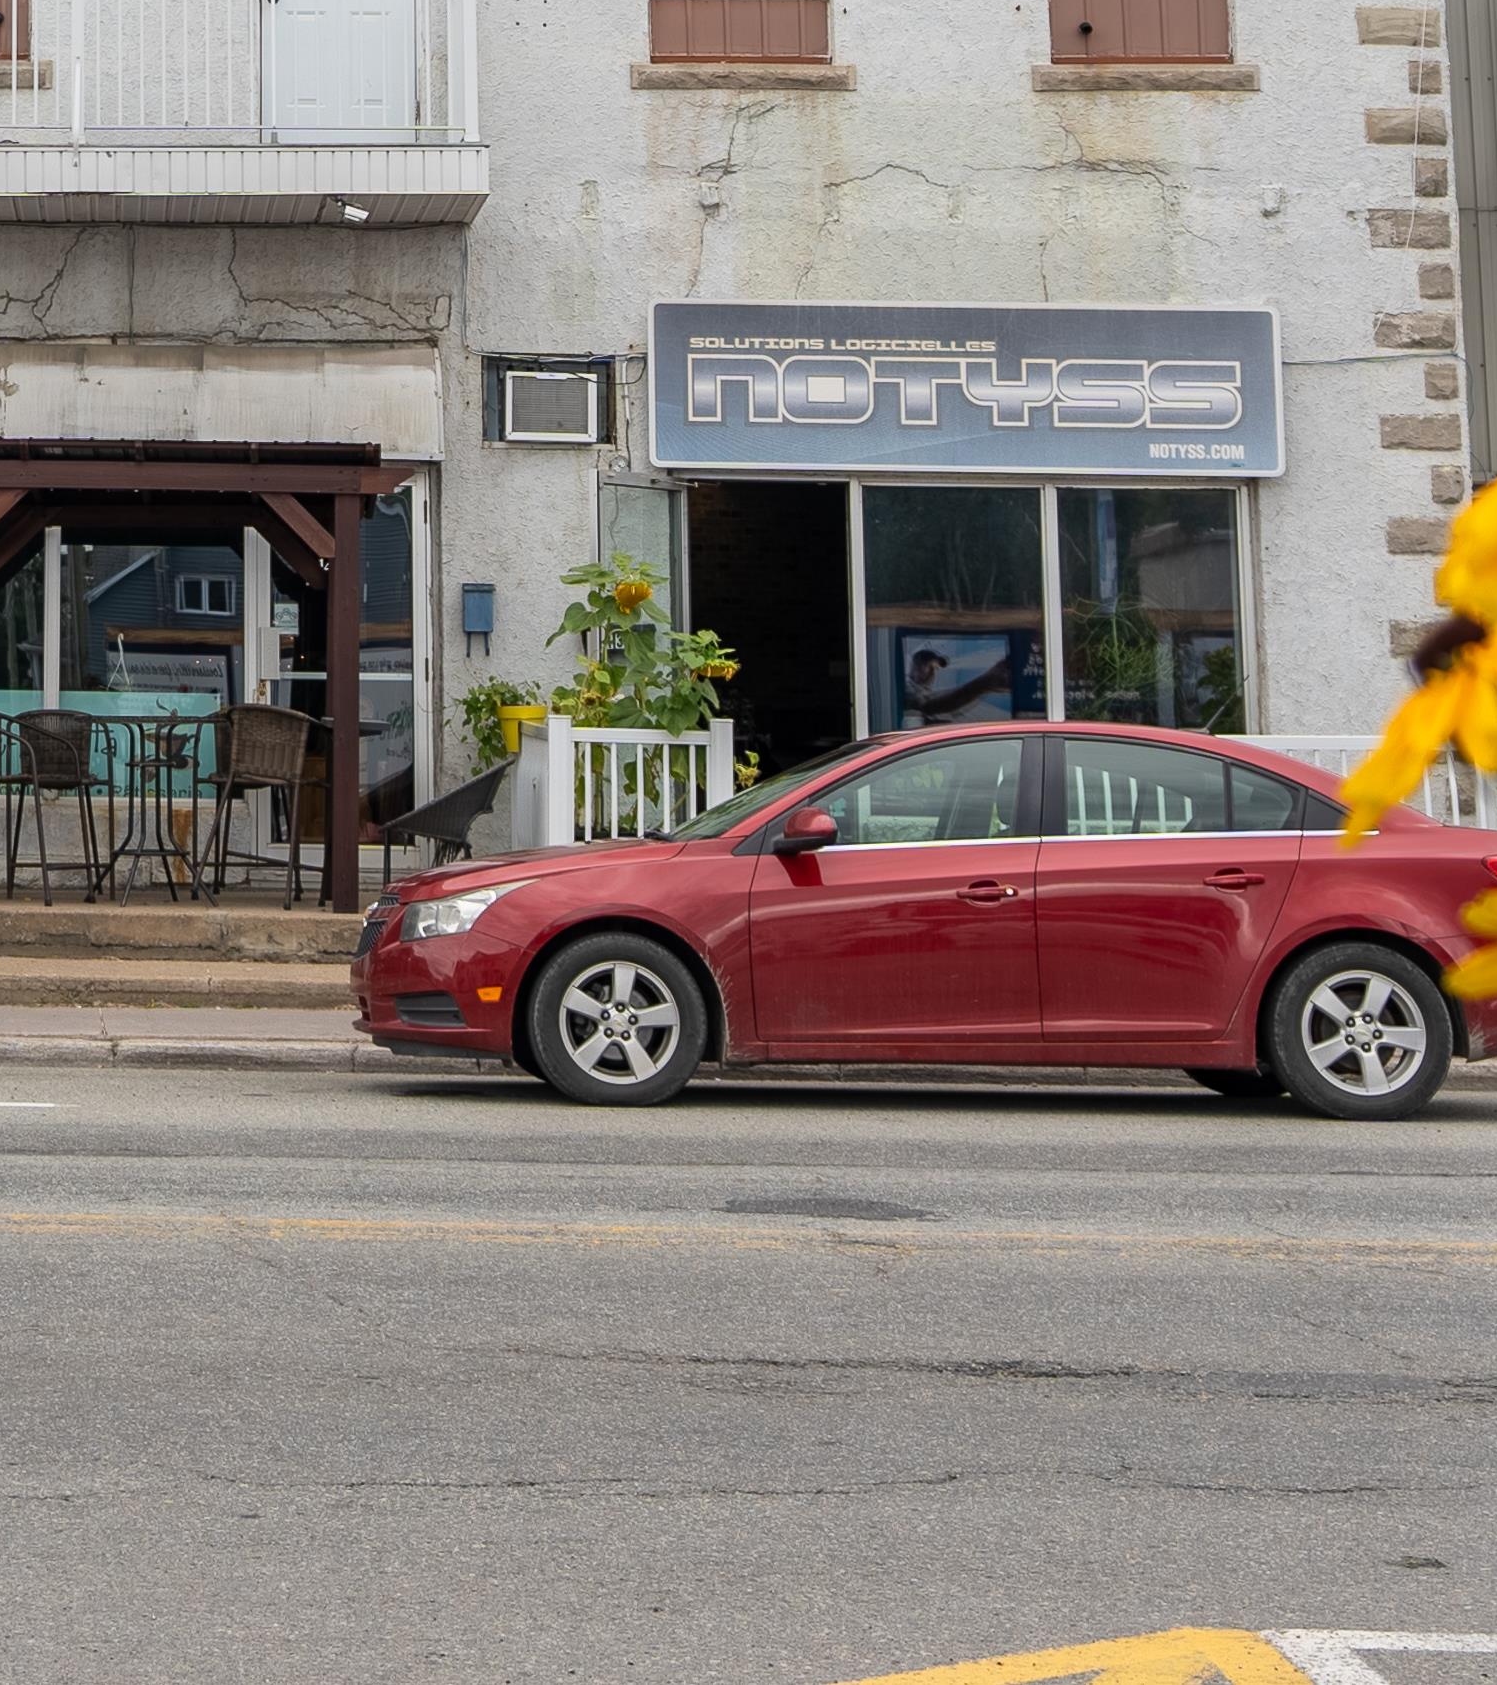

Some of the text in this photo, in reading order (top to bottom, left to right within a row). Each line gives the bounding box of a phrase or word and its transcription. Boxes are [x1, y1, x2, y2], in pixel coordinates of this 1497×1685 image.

[688, 336, 996, 352] SOLUTIONS LOGICIELLES
[686, 353, 1243, 430] NOTYSS
[1148, 443, 1245, 460] NOTYSS.COM
